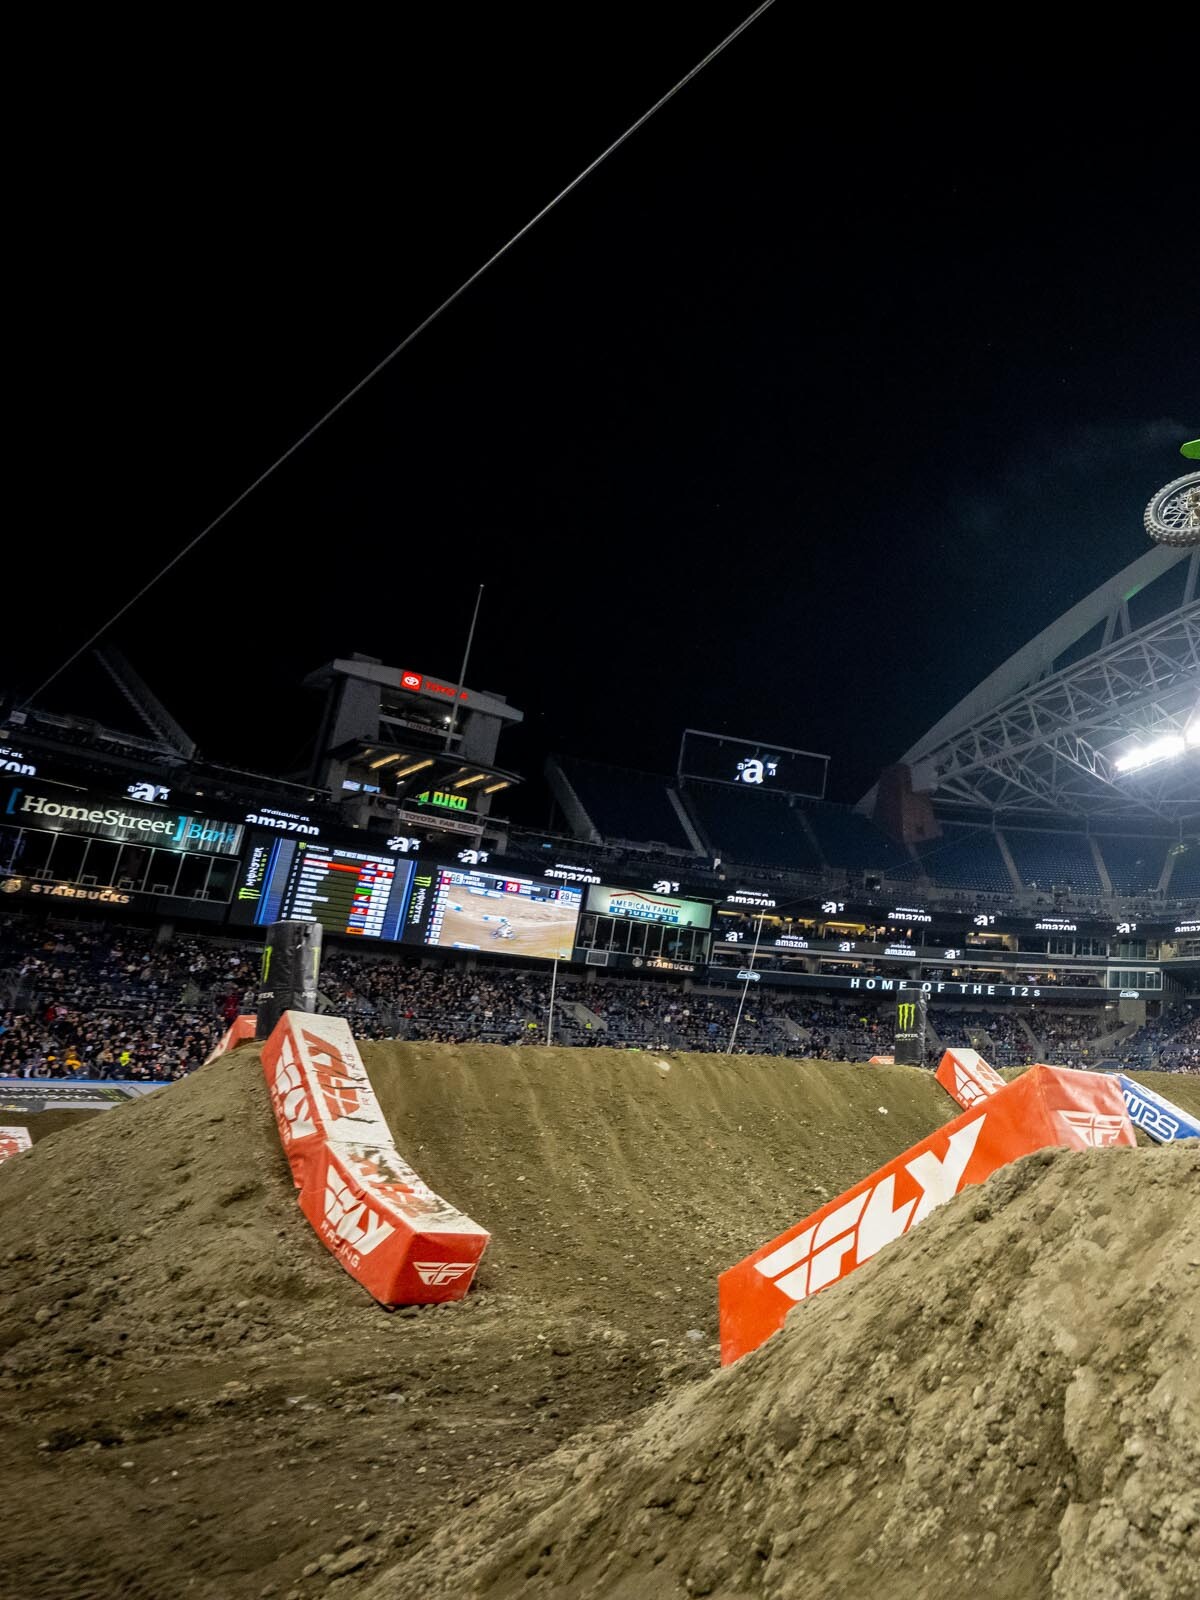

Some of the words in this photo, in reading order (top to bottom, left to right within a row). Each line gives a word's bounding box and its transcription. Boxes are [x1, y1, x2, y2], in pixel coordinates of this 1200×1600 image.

[425, 681, 468, 700] TOYOA
[245, 814, 320, 836] amazon
[404, 812, 438, 825] TOYOTA
[439, 818, 456, 828] FAN
[458, 822, 480, 833] DECK
[186, 823, 235, 844] Bank
[544, 869, 602, 884] amazon
[496, 881, 503, 890] 2
[30, 884, 130, 904] STARBUCKS
[550, 890, 556, 898] 3
[610, 898, 652, 912] AMERICAN
[653, 904, 680, 916] FAMILY
[727, 896, 776, 908] amazon
[888, 912, 932, 922] amazon
[1035, 922, 1077, 932] amazon
[775, 938, 808, 949] amazon
[884, 947, 916, 957] amazon
[646, 960, 695, 972] STARBUCKS
[850, 978, 908, 990] HOME
[922, 982, 946, 993] OF
[960, 984, 996, 995] THE
[1010, 986, 1041, 997] 12s
[1123, 1090, 1179, 1143] WPS
